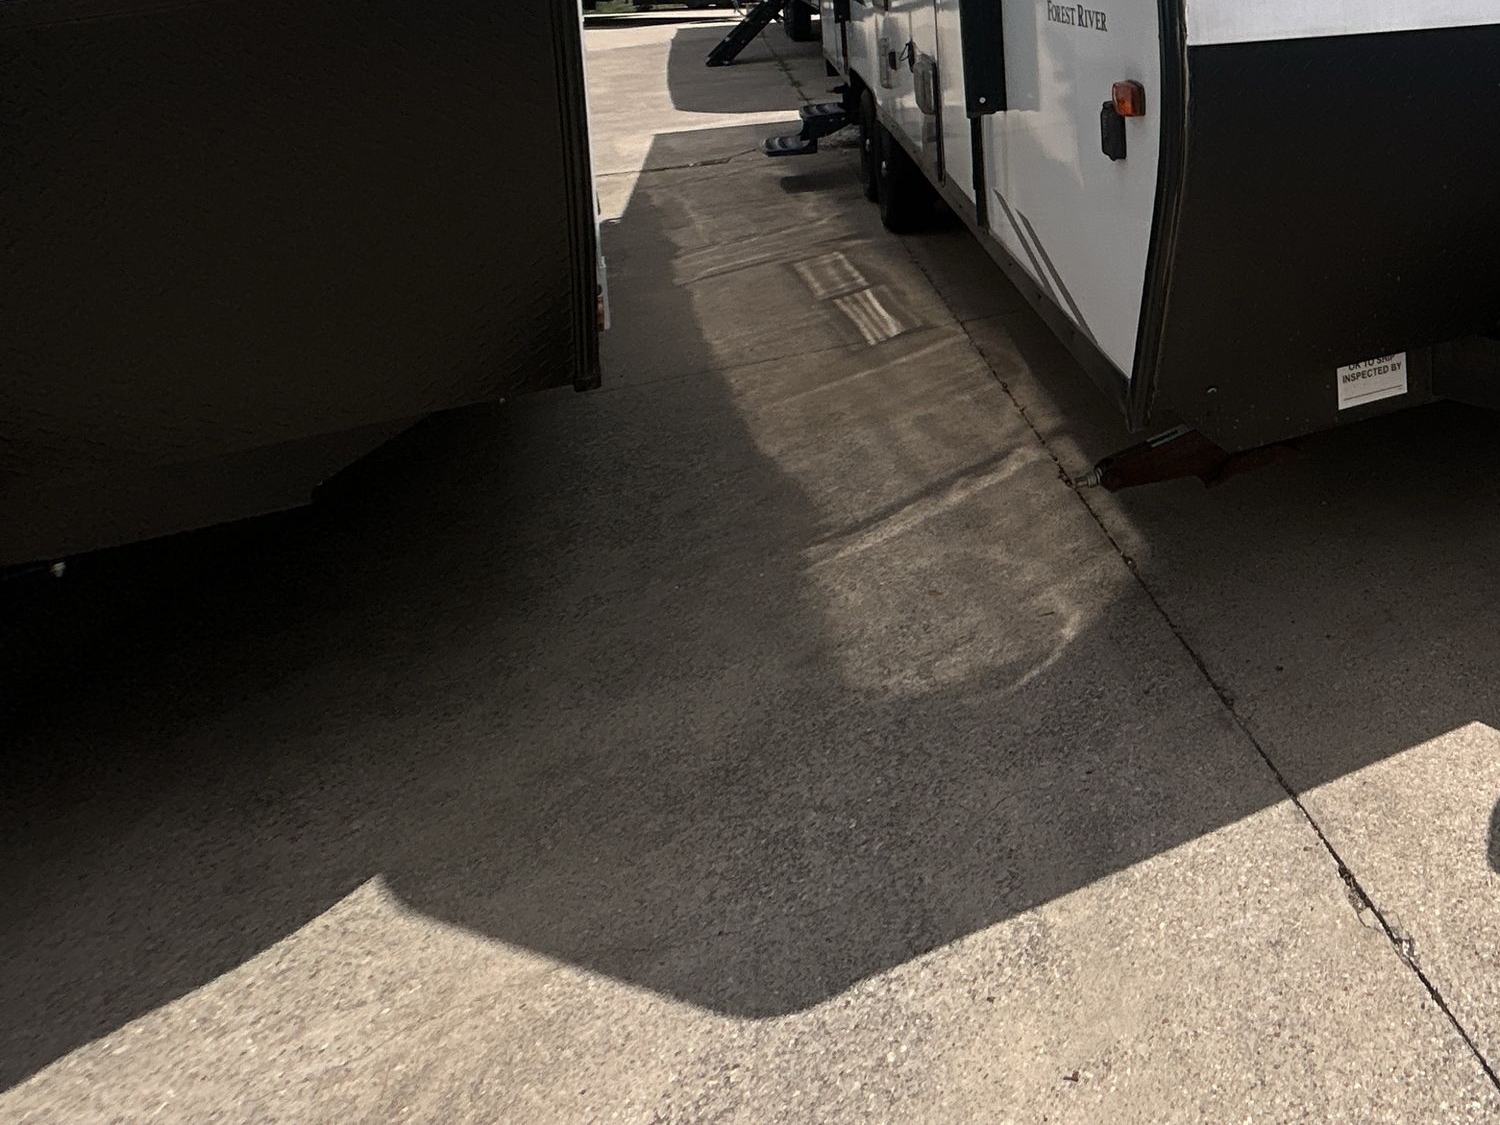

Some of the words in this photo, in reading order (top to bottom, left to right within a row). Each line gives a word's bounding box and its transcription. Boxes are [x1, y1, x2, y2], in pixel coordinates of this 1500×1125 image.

[1047, 0, 1076, 26] FOREST
[1077, 3, 1108, 32] RIVER
[1342, 364, 1389, 384] INSPECTED
[1390, 362, 1402, 372] BY
